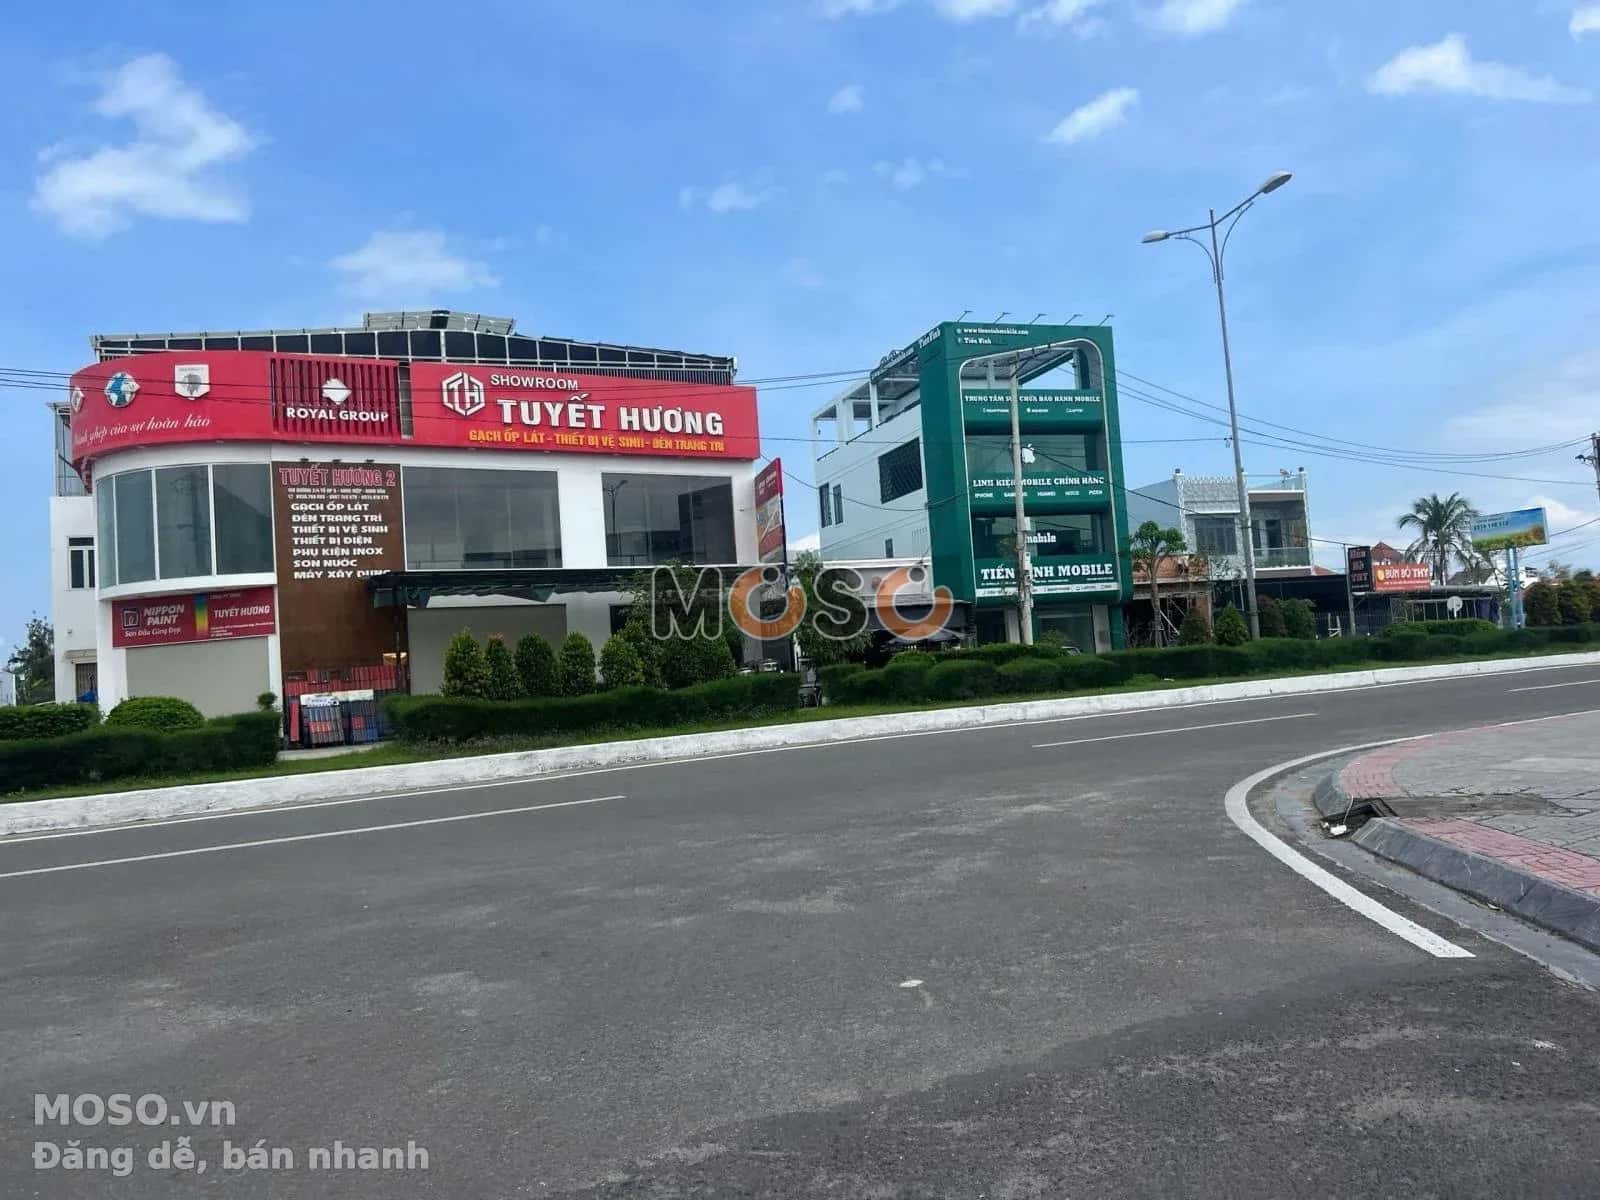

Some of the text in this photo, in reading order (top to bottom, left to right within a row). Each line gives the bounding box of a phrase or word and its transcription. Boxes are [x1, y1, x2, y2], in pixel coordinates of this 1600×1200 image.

[490, 374, 579, 390] SHOWROOM
[287, 407, 389, 422] ROYAL GROUP
[496, 393, 725, 436] TUYẾT HƯƠNG
[147, 415, 179, 432] hoàn
[469, 430, 502, 444] GẠCH
[504, 428, 521, 443] ỐP
[523, 430, 545, 444] LÁT
[555, 432, 585, 446] THIẾT
[588, 435, 599, 448] BỊ
[600, 435, 615, 449] VỆ
[618, 437, 645, 448] SINH
[674, 438, 707, 451] TRANG
[279, 464, 396, 487] TUYẾT HƯƠNG 2
[290, 500, 370, 514] GẠCH ỐP LÁT
[320, 514, 361, 522] TRANG
[363, 513, 382, 522] TRÍ
[291, 523, 388, 535] THIẾT BỊ VỆ SINH
[292, 534, 373, 546] THIẾT BỊ ĐIỆN
[292, 546, 384, 557] PHỤ KIỆN INOX
[323, 557, 358, 567] NƯỚC
[293, 569, 323, 580] MÁY
[327, 569, 357, 579] XÂY
[981, 564, 1015, 580] TIẾN
[1057, 563, 1113, 577] MOBILE
[1412, 567, 1429, 578] THY
[144, 604, 185, 615] NIPPON
[214, 604, 271, 619] TUYẾT HƯƠNG
[146, 614, 178, 626] PAINT
